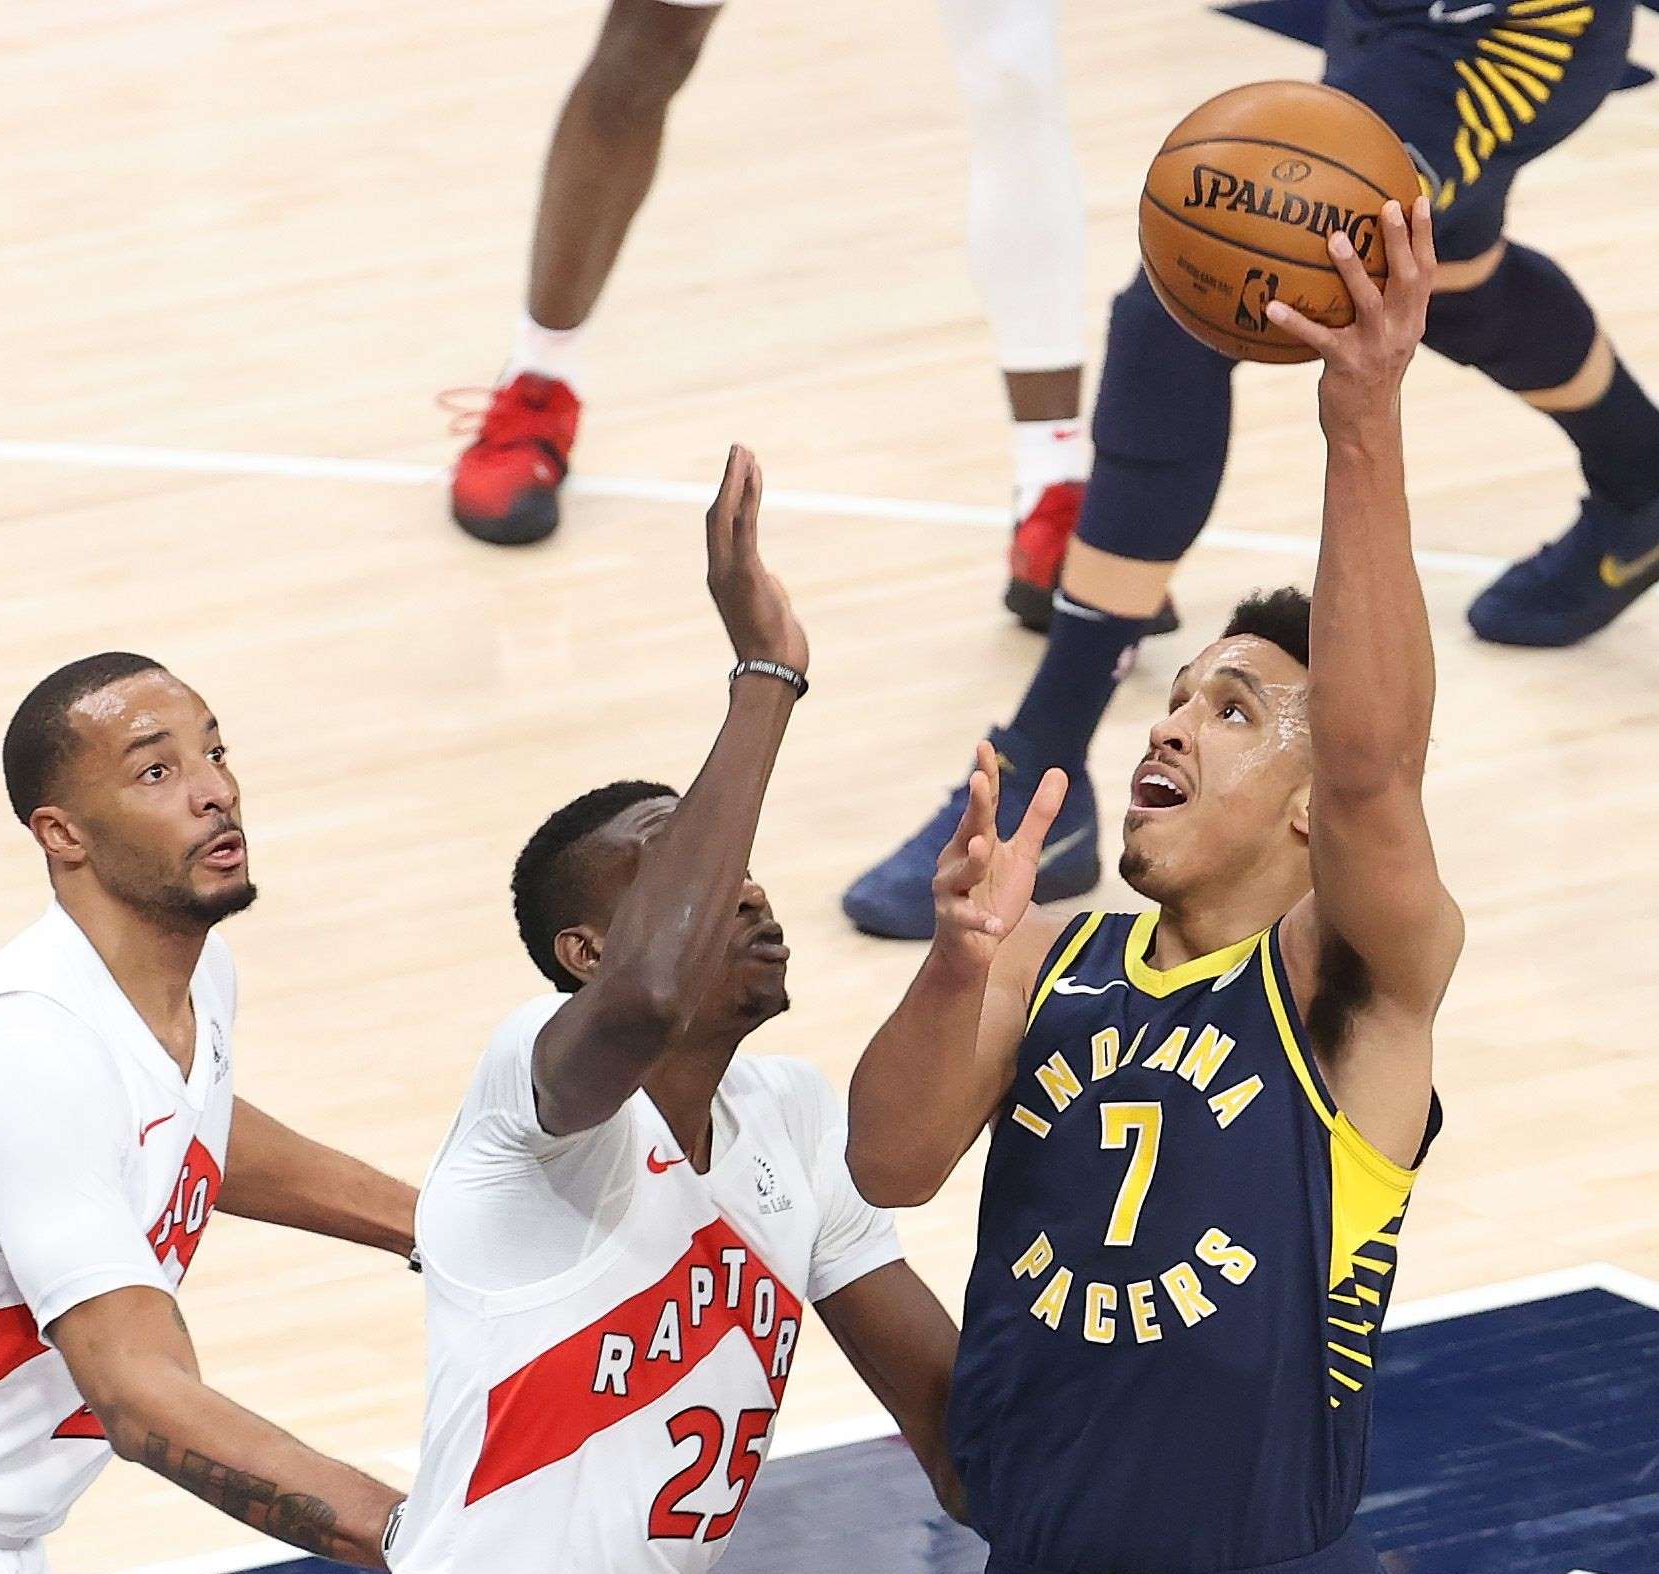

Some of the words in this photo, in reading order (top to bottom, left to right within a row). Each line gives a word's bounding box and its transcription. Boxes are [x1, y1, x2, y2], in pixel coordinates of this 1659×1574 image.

[1184, 164, 1380, 260] SPALDING
[1012, 1022, 1265, 1140] INDIANA
[1098, 1101, 1163, 1247] 7
[1012, 1227, 1258, 1343] PACERS
[647, 1405, 777, 1544] 25
